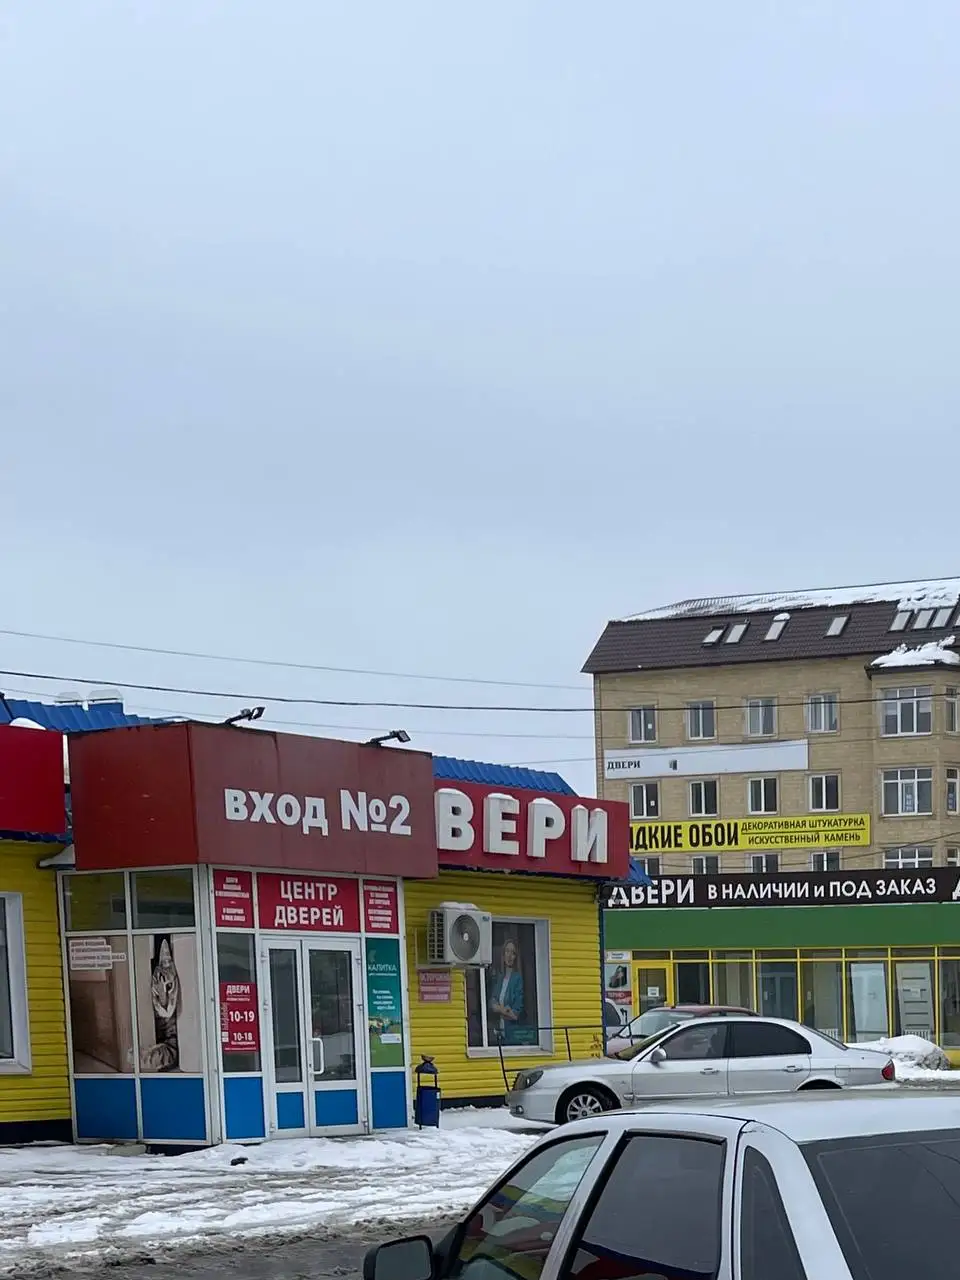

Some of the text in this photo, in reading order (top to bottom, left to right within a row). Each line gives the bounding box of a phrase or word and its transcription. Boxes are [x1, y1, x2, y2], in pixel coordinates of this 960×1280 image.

[607, 760, 641, 770] ДВЕРИ
[225, 788, 411, 836] ВХОД №2
[434, 787, 608, 864] ВЕРИ
[741, 817, 865, 832] ДЕКОРАТИВНАЯ ШТУКАТУРКА
[629, 822, 739, 850] ДКИЕ ОБОИ
[748, 831, 861, 845] ИСКУССТВЕННЫЙ КАМЕНЬ
[281, 880, 338, 902] ЦЕНТР
[708, 884, 718, 900] В
[722, 882, 809, 899] НАЛИЧИИ
[829, 880, 872, 899] ПОД
[876, 878, 937, 896] ЗАКАЗ
[274, 905, 344, 927] ДВЕРЕЙ
[226, 984, 250, 995] ДВЕРИ
[229, 1010, 255, 1022] 10-19
[233, 1032, 253, 1041] 10-18
